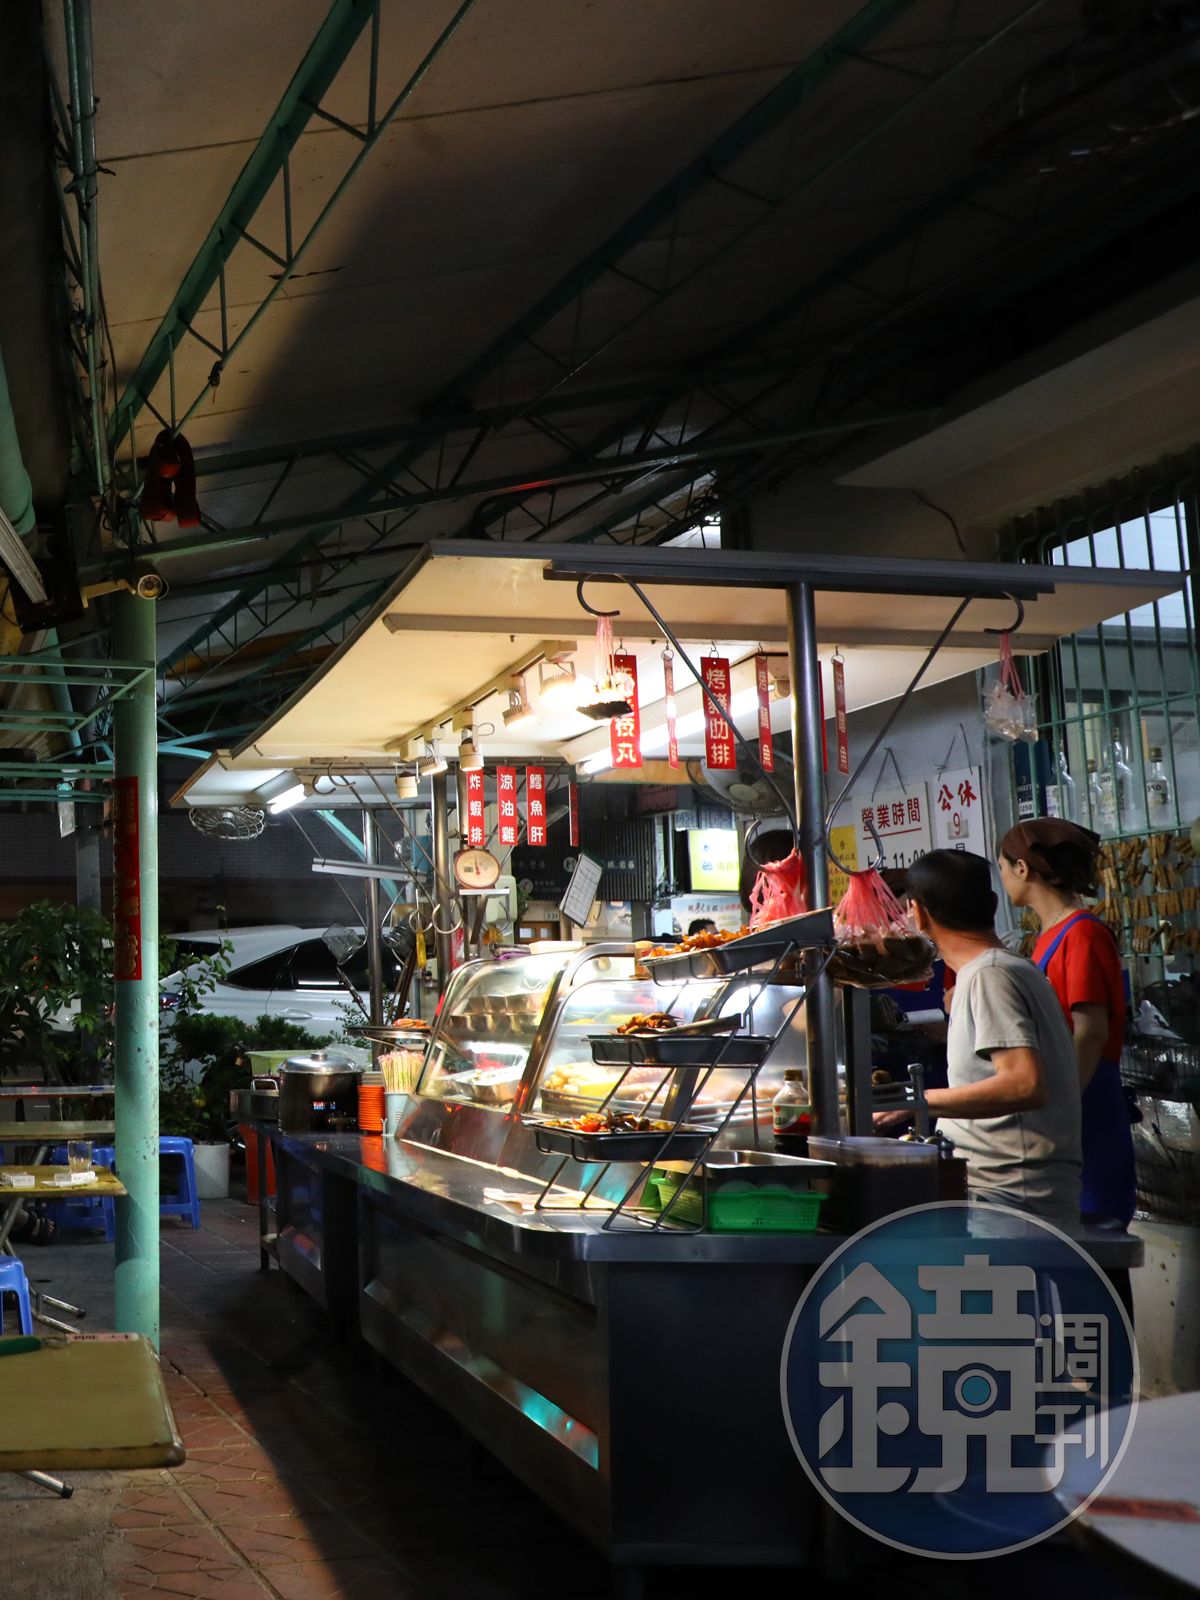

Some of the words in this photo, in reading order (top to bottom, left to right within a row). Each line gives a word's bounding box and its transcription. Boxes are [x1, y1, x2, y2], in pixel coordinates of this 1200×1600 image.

[707, 668, 731, 765] 烤豬肋排
[469, 773, 482, 843] 炸蝦排
[500, 773, 515, 843] 涼油雞
[861, 797, 921, 832] 營業時間
[937, 780, 977, 812] 公休
[953, 813, 961, 836] 9
